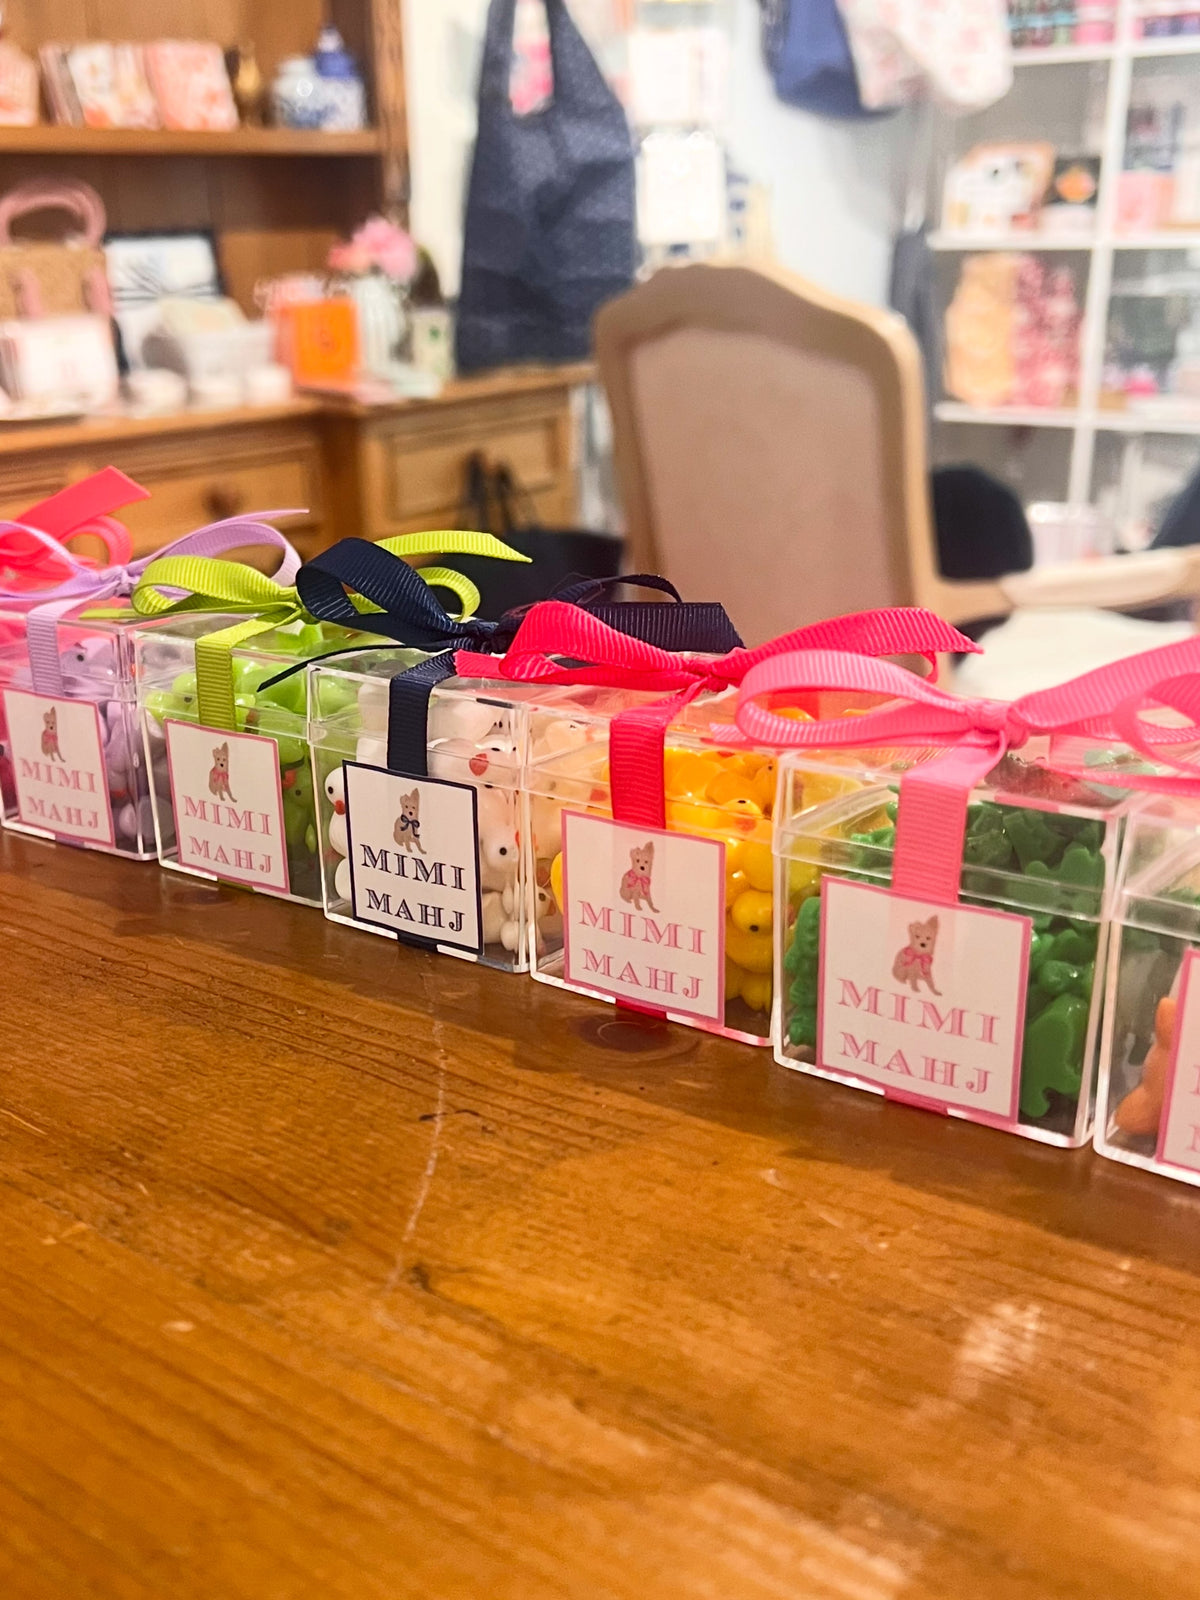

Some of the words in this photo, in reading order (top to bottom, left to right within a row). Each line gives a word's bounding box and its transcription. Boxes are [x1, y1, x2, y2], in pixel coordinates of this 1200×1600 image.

[19, 758, 97, 793] MIMI
[27, 796, 99, 830] MAHJ
[182, 795, 272, 836] MIMI
[189, 836, 273, 874] MAHJ
[360, 844, 466, 891] MIMI
[365, 888, 465, 932] MAHJ
[577, 900, 707, 955] MIMI
[582, 948, 703, 1000] MAHJ
[837, 978, 1000, 1045] MIMI
[840, 1031, 993, 1094] MAHJ
